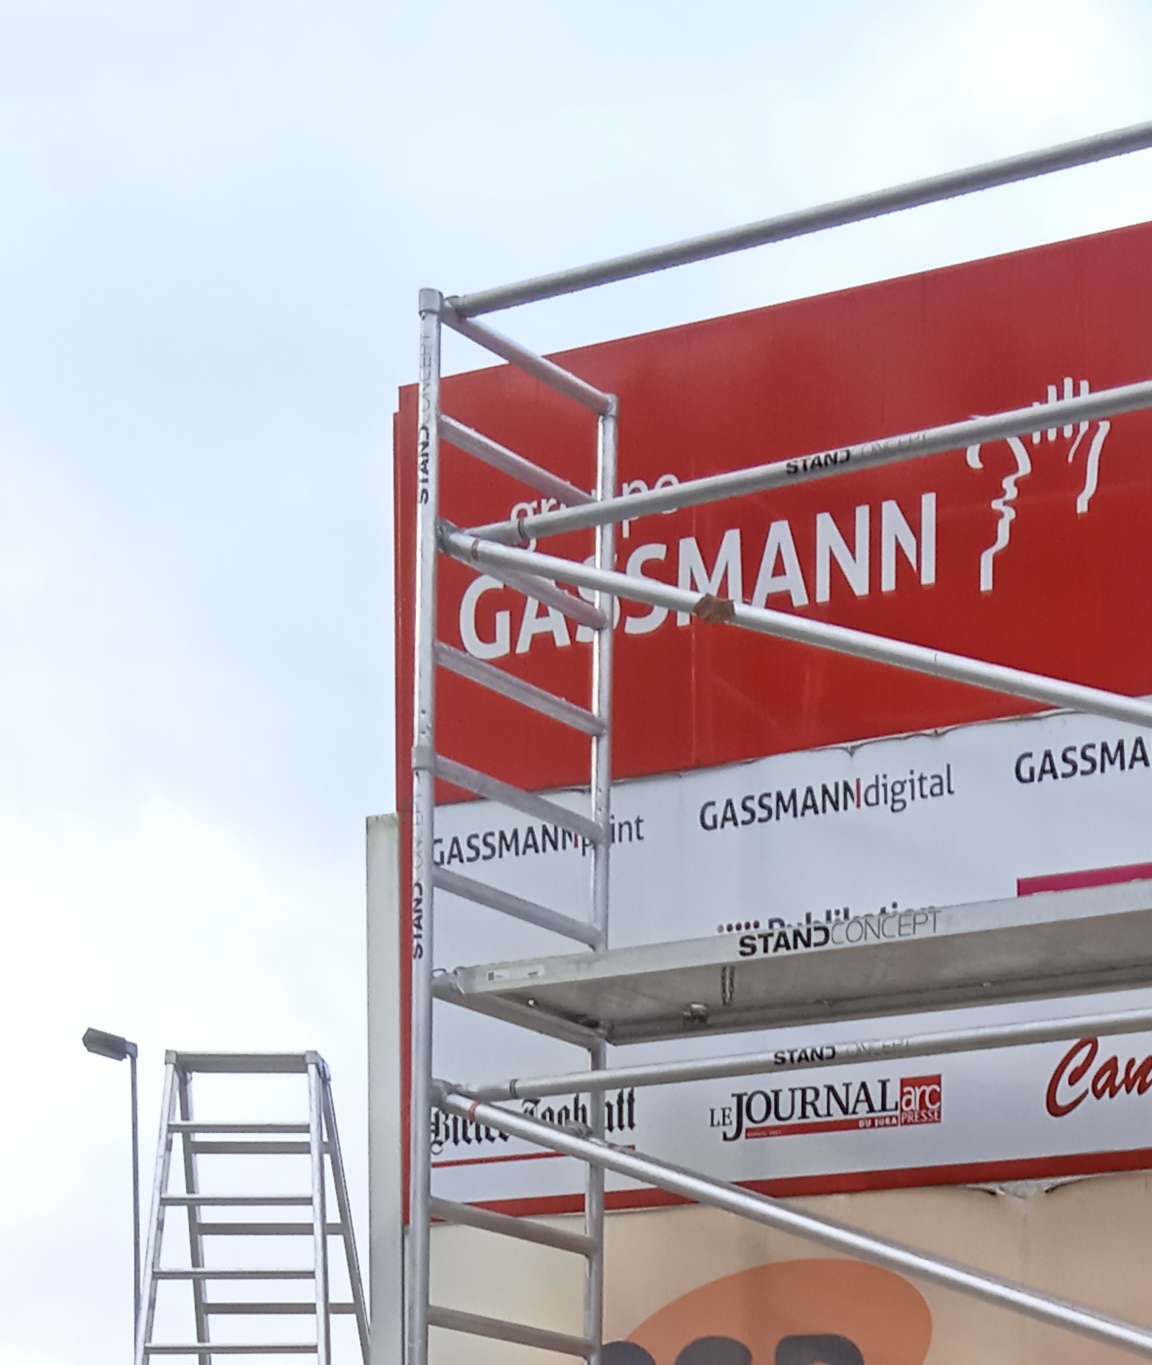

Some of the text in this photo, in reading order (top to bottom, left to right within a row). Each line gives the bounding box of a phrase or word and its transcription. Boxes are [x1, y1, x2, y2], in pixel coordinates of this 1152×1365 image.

[510, 473, 681, 554] grpe
[459, 491, 937, 661] GASSMANN
[433, 815, 645, 866] GASSMANNpint
[709, 1078, 900, 1142] LE JOURNAL
[874, 1116, 898, 1128] JURA
[901, 1083, 941, 1112] arc
[901, 1108, 941, 1126] PRESSE
